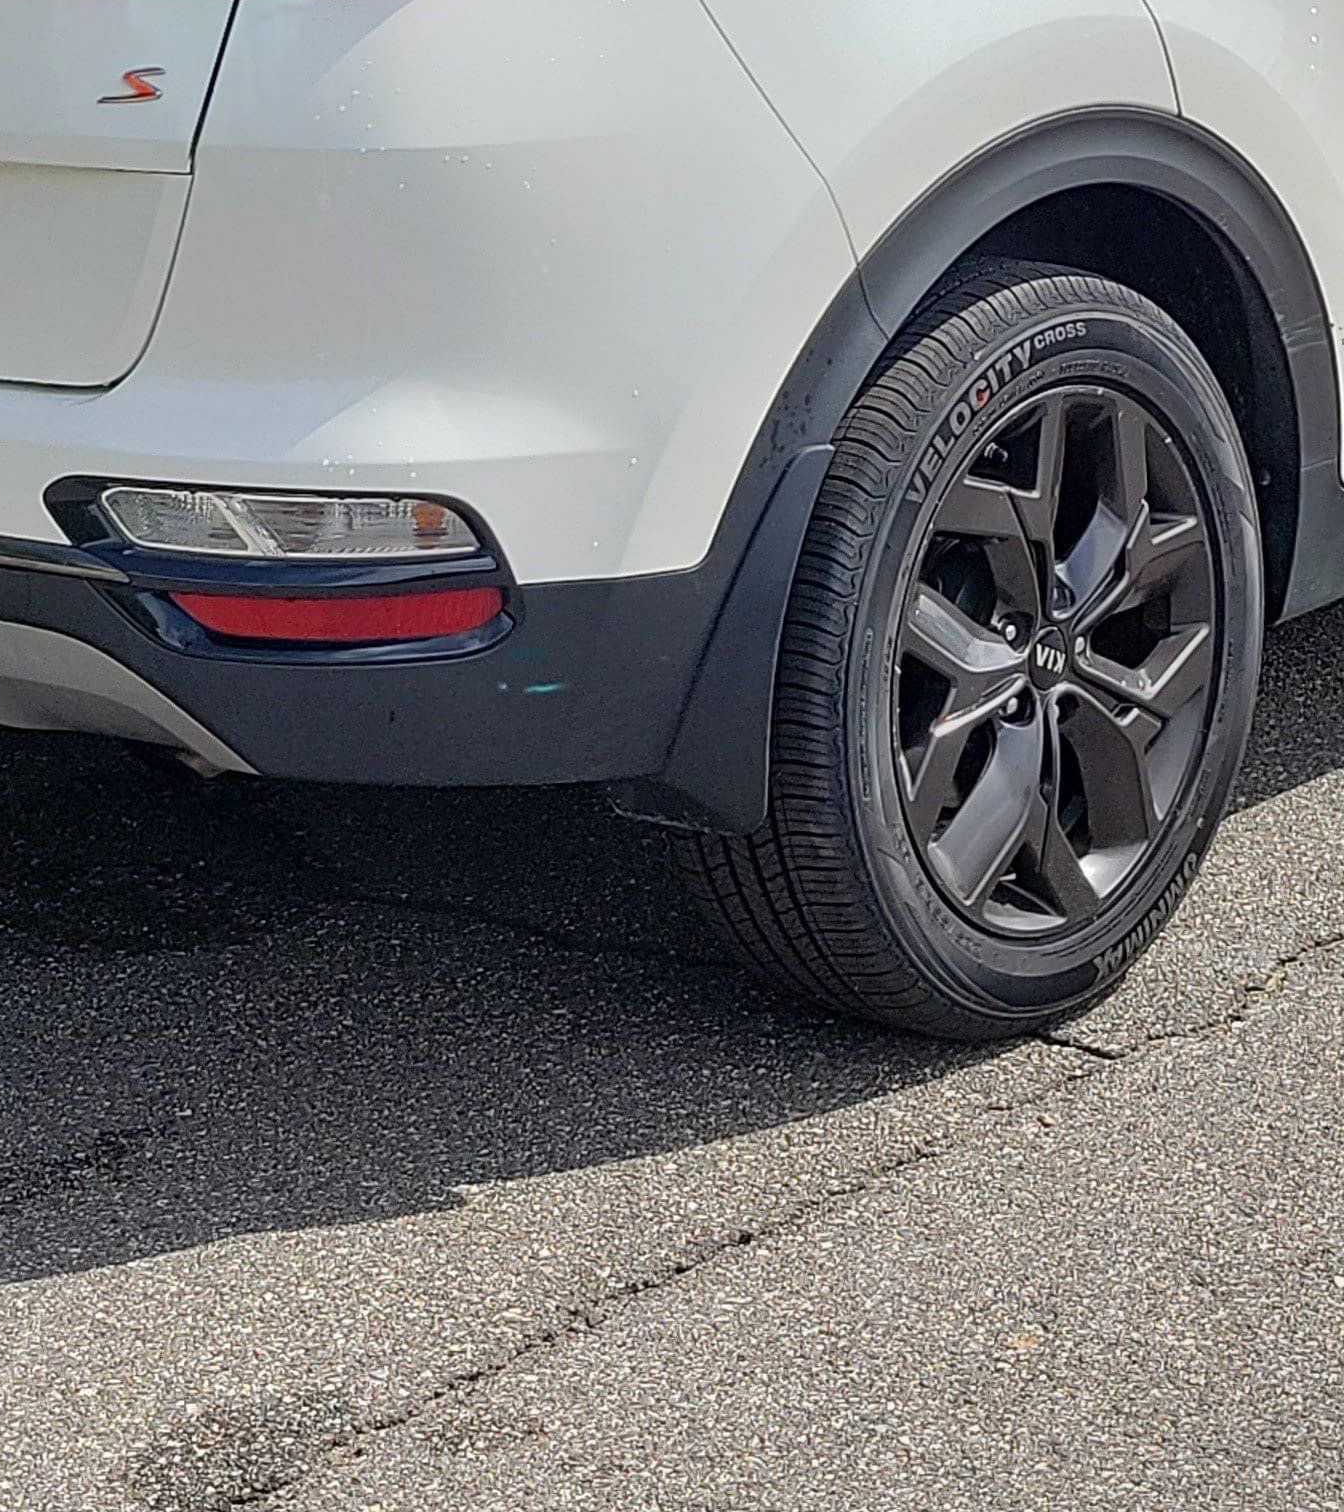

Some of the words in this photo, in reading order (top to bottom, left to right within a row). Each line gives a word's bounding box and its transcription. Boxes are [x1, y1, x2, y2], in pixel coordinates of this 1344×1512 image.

[97, 67, 166, 104] S
[905, 339, 1032, 504] VELOCITY
[1034, 321, 1087, 349] CROSS
[1036, 643, 1066, 674] KIA
[1093, 852, 1198, 981] OMNIMAX
